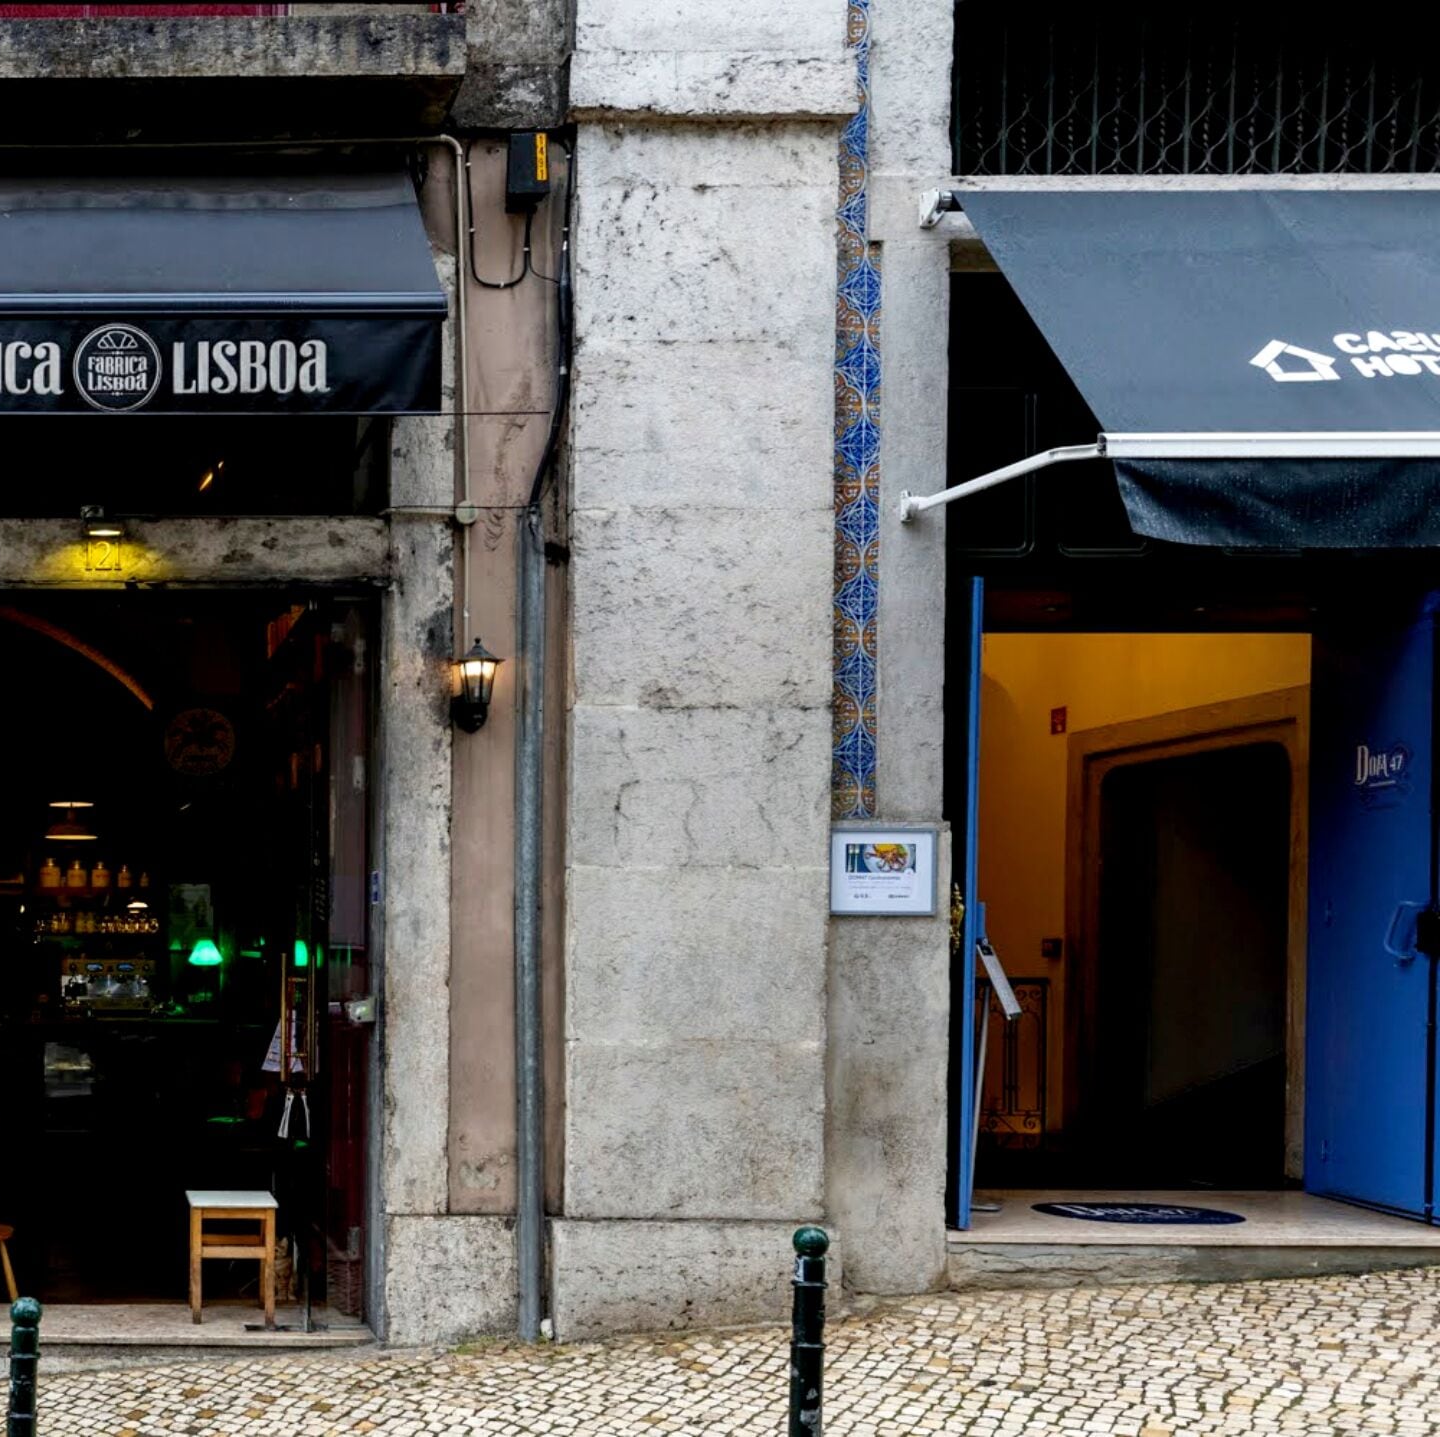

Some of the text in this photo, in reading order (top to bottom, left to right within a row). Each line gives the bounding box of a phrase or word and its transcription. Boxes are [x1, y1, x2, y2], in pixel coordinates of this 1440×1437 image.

[172, 339, 331, 394] LISBOA
[87, 372, 147, 391] LISBOA
[85, 541, 122, 571] 121
[1389, 754, 1404, 771] 47
